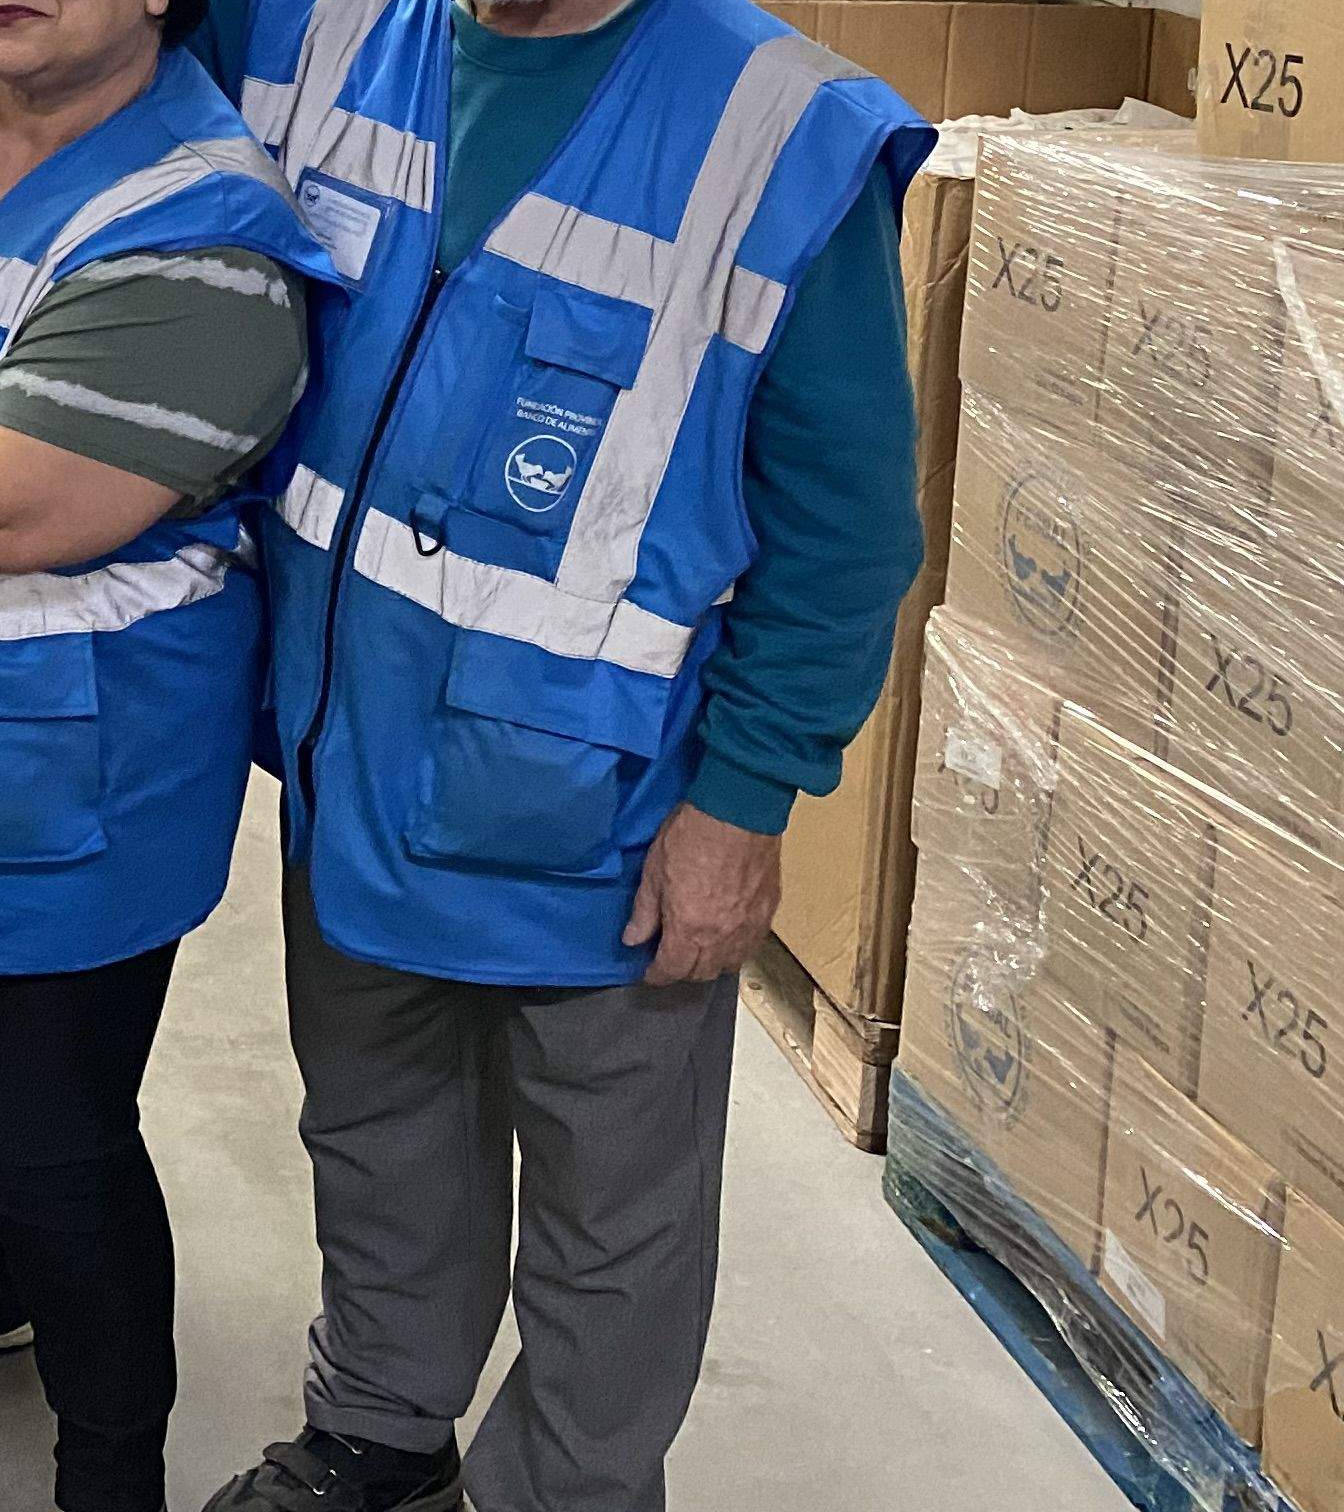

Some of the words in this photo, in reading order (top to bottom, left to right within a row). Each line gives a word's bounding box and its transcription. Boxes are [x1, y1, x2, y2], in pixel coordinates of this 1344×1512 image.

[1220, 42, 1304, 119] X25
[992, 236, 1064, 313] X25
[1131, 298, 1213, 388] X25
[545, 417, 559, 427] DE
[1205, 634, 1293, 737] X25
[1070, 835, 1150, 943] X25
[1241, 959, 1328, 1079] X25
[1134, 1165, 1209, 1287] X25
